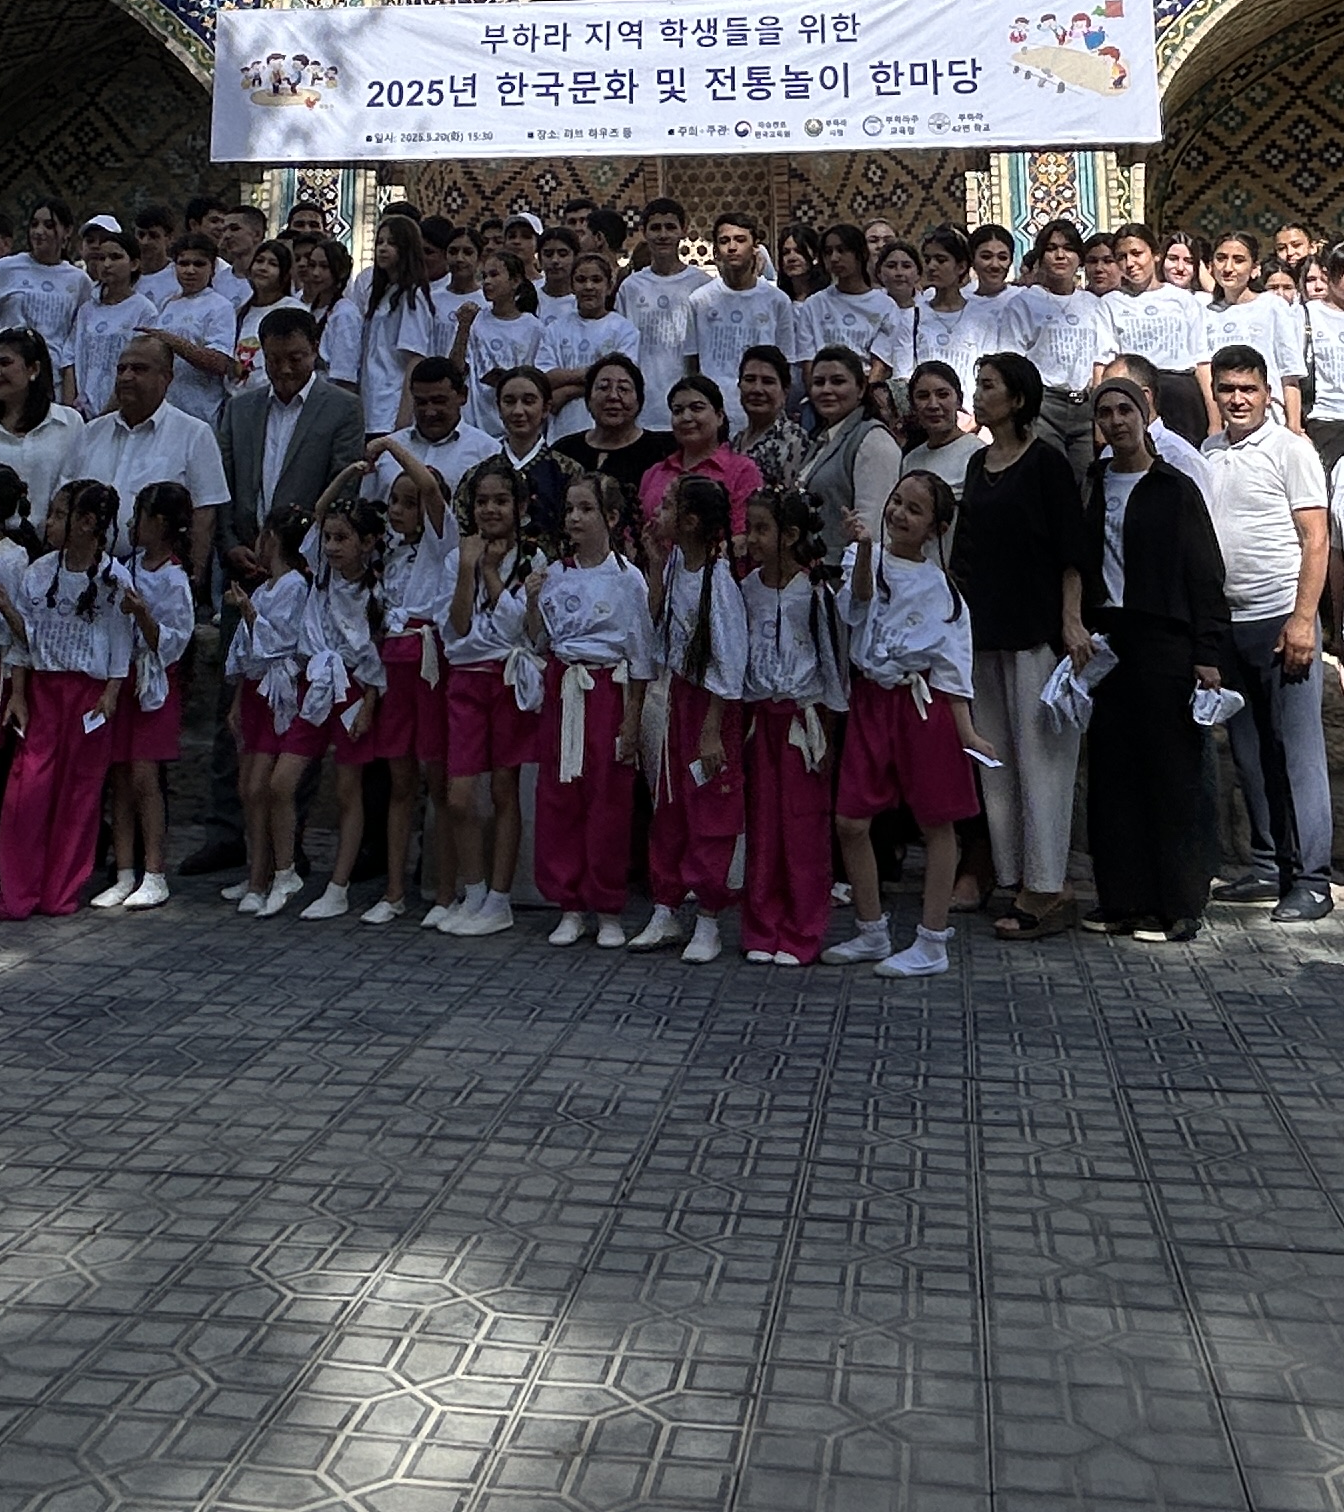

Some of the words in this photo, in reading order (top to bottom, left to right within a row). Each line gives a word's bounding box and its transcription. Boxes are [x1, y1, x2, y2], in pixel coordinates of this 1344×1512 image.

[480, 21, 572, 55] 부하라
[584, 19, 643, 52] 지역
[658, 15, 784, 49] 학생들을
[797, 12, 862, 45] 위한
[365, 72, 478, 108] 2025년
[495, 68, 640, 107] 한국문화
[656, 66, 688, 104] 및
[704, 62, 850, 102] 전통놀이
[868, 57, 983, 97] 한마당
